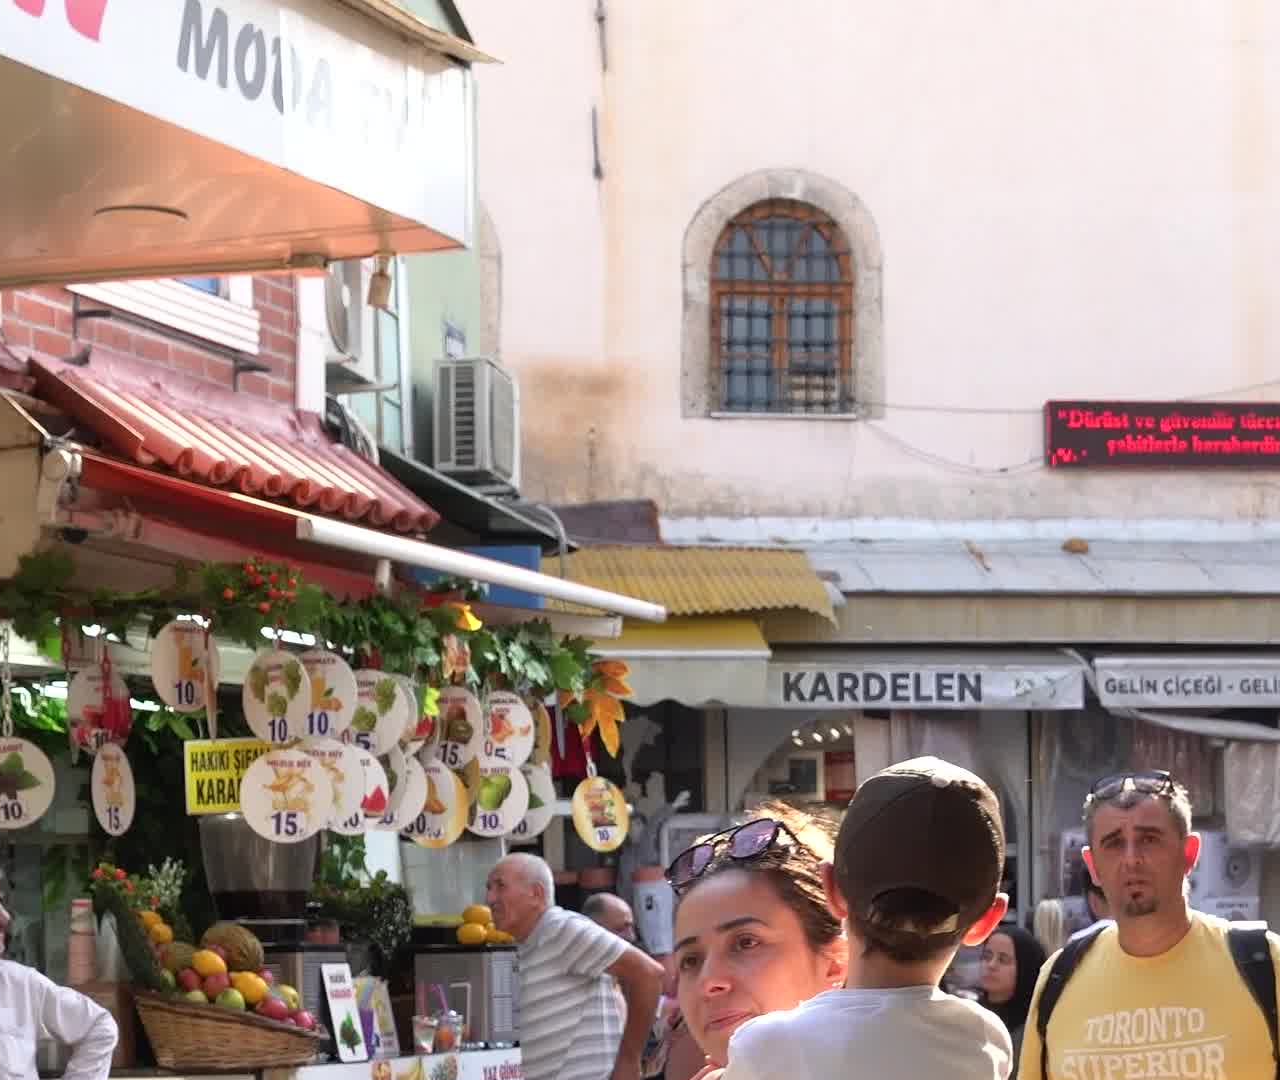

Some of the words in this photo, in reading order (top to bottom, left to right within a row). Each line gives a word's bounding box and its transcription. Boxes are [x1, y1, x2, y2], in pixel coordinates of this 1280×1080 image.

[1136, 415, 1156, 428] ve
[175, 680, 195, 705] 10
[783, 671, 983, 702] KARDELEN
[1104, 674, 1158, 695] GELİN
[269, 718, 288, 742] 10
[308, 711, 329, 735] 10
[440, 743, 460, 766] 15
[0, 801, 22, 820] 10
[106, 806, 120, 831] 15
[479, 814, 499, 830] 10
[272, 812, 299, 836] 15
[1086, 1007, 1206, 1045] TORONTO
